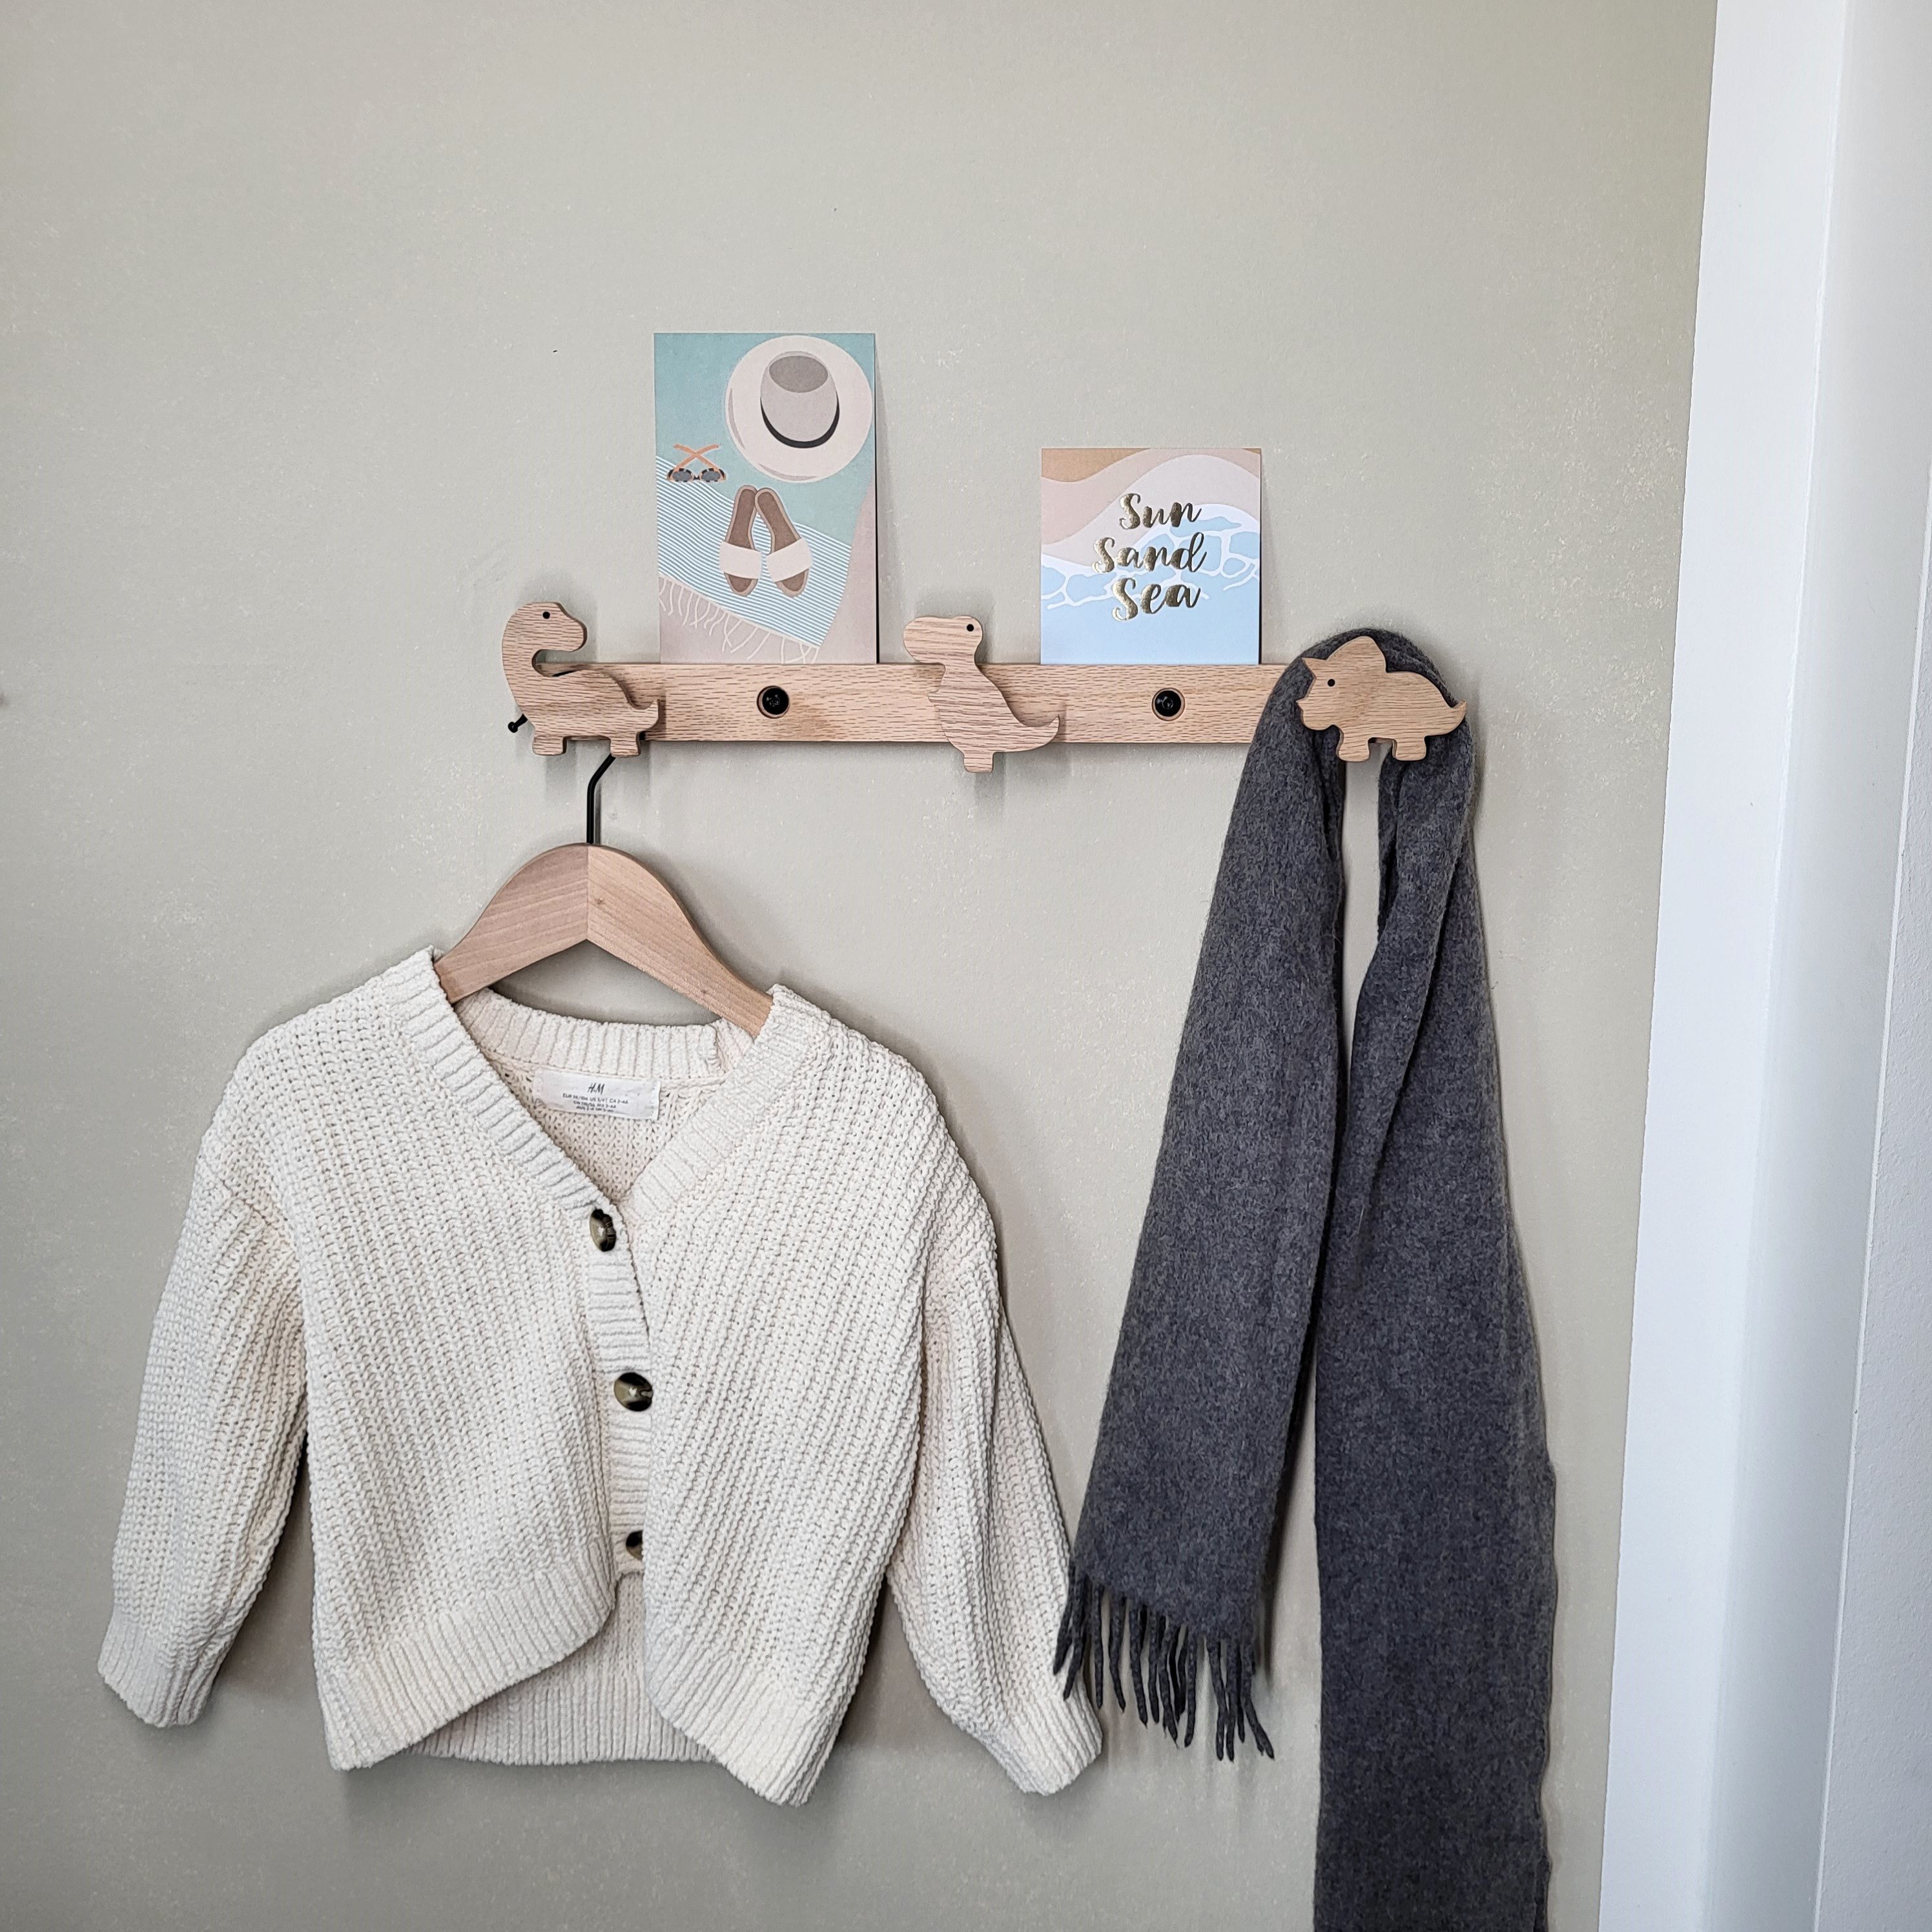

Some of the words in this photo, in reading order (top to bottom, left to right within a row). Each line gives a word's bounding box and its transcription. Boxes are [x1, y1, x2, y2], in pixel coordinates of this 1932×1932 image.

[1119, 493, 1202, 529] Sun
[1091, 531, 1207, 573] Sand
[1112, 577, 1201, 621] Sea
